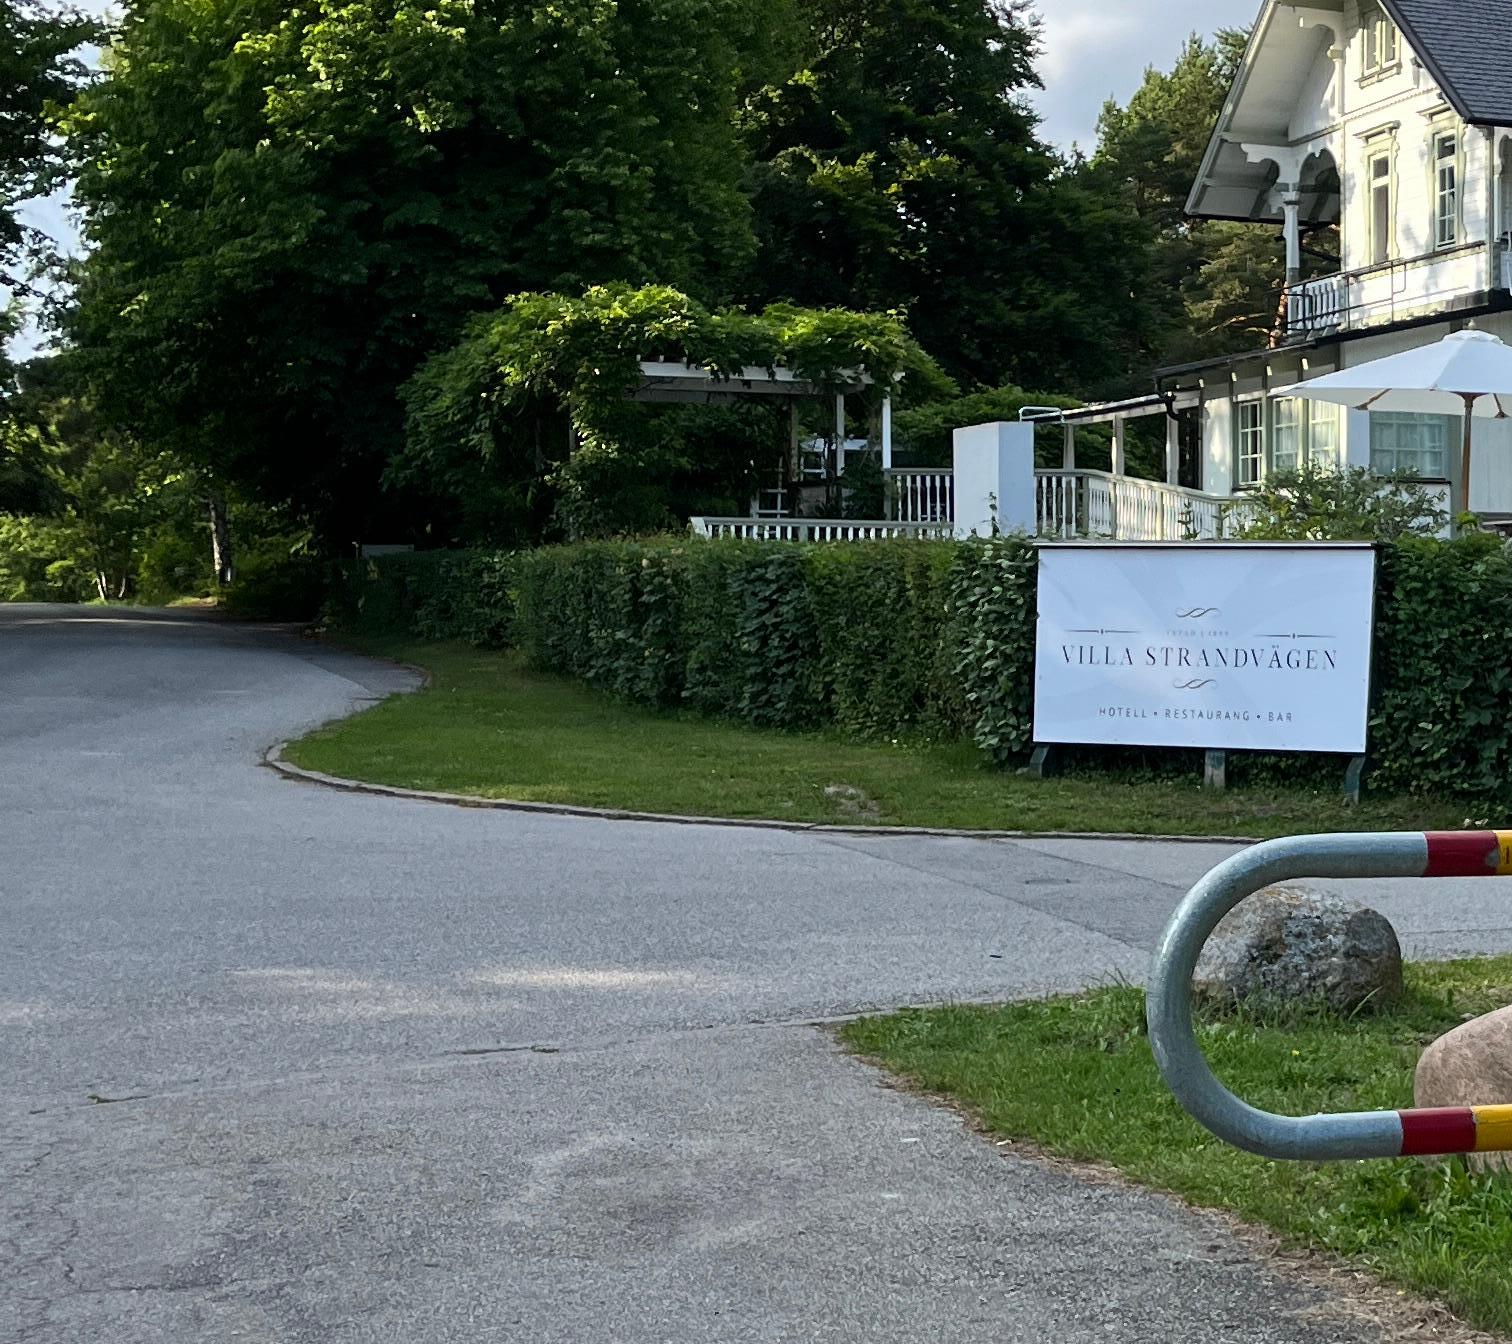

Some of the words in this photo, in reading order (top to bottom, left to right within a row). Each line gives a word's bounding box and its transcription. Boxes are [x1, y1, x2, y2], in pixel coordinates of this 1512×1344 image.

[1061, 644, 1134, 666] VILLA
[1146, 645, 1337, 670] STRANDVÄGEN
[1098, 707, 1148, 719] HOTELL
[1164, 709, 1251, 722] RESTAURANG
[1267, 711, 1294, 723] BAR
